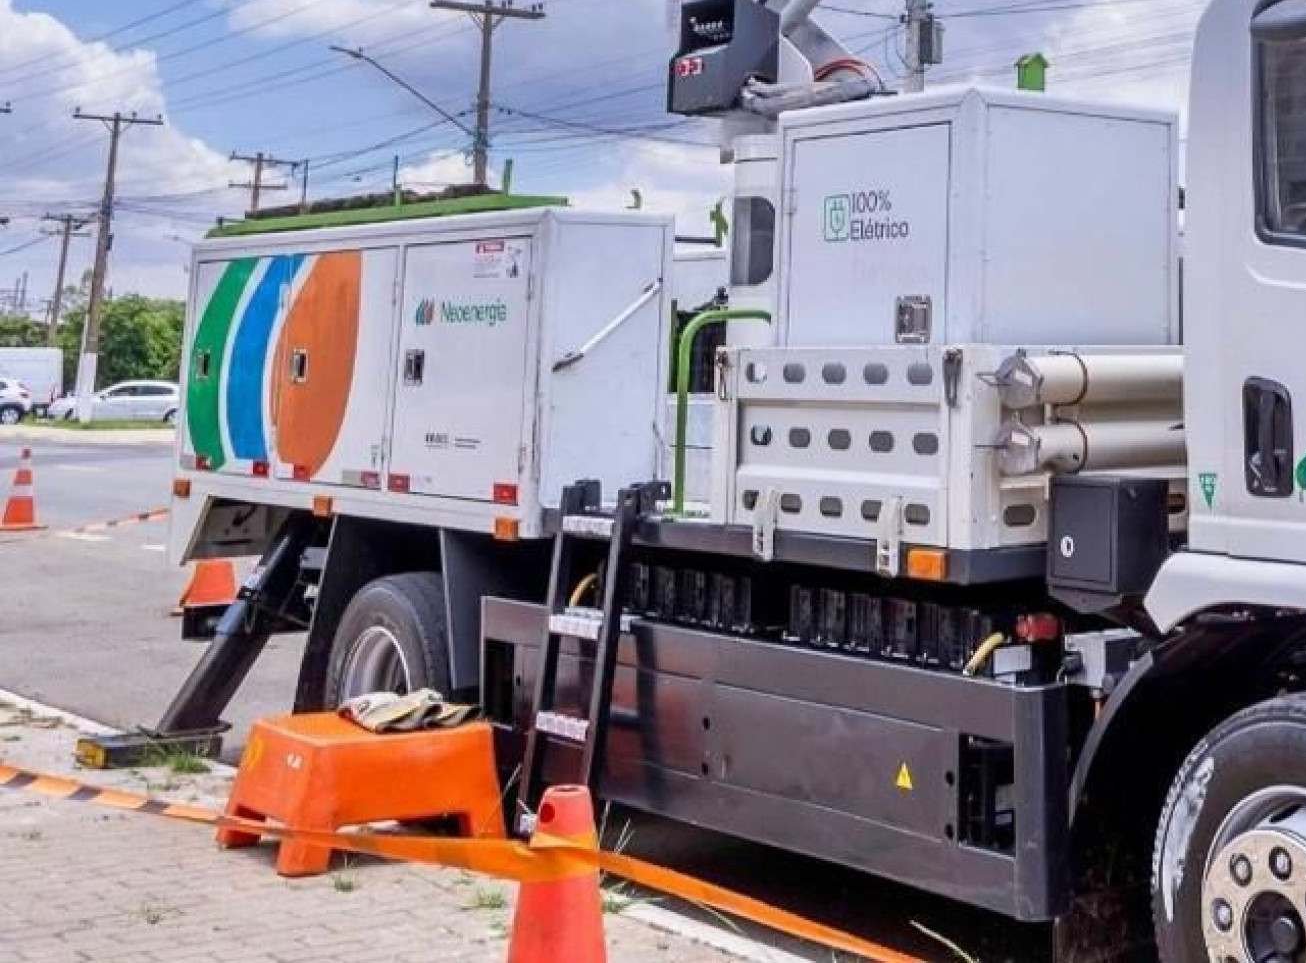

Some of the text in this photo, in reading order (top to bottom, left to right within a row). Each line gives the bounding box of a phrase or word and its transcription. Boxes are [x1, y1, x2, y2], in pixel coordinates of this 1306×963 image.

[851, 190, 892, 213] 100%
[850, 217, 909, 241] Elétrico
[440, 299, 507, 327] Neoenergia
